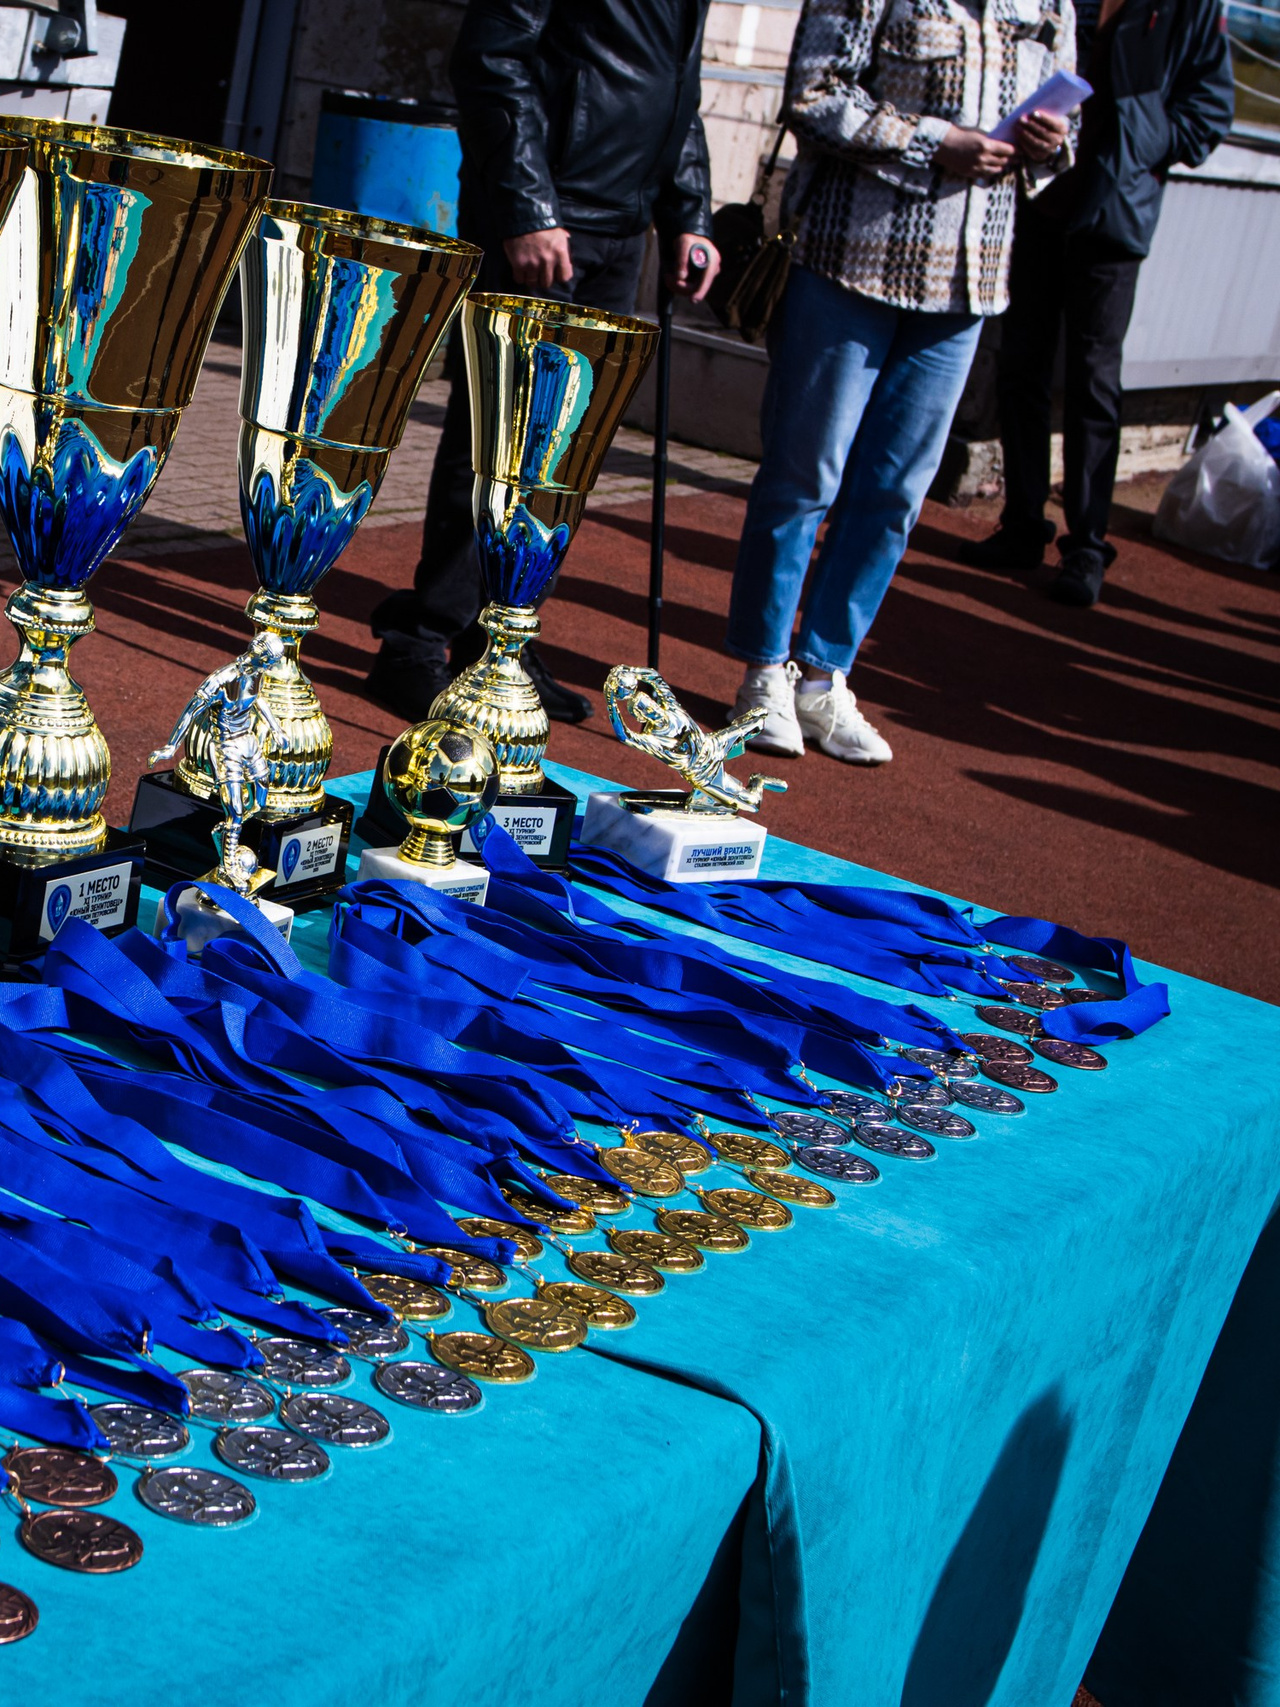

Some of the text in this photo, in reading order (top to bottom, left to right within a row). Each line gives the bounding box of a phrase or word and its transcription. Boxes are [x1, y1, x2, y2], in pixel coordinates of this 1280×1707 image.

[504, 817, 544, 828] 3 МЕСТО
[306, 836, 334, 852] 2 МЕСТО
[691, 846, 752, 857] ЛУЧШИЙ ВРАТАРЬ
[79, 874, 120, 898] 1 МЕСТО
[92, 892, 112, 903] ТУРНИР
